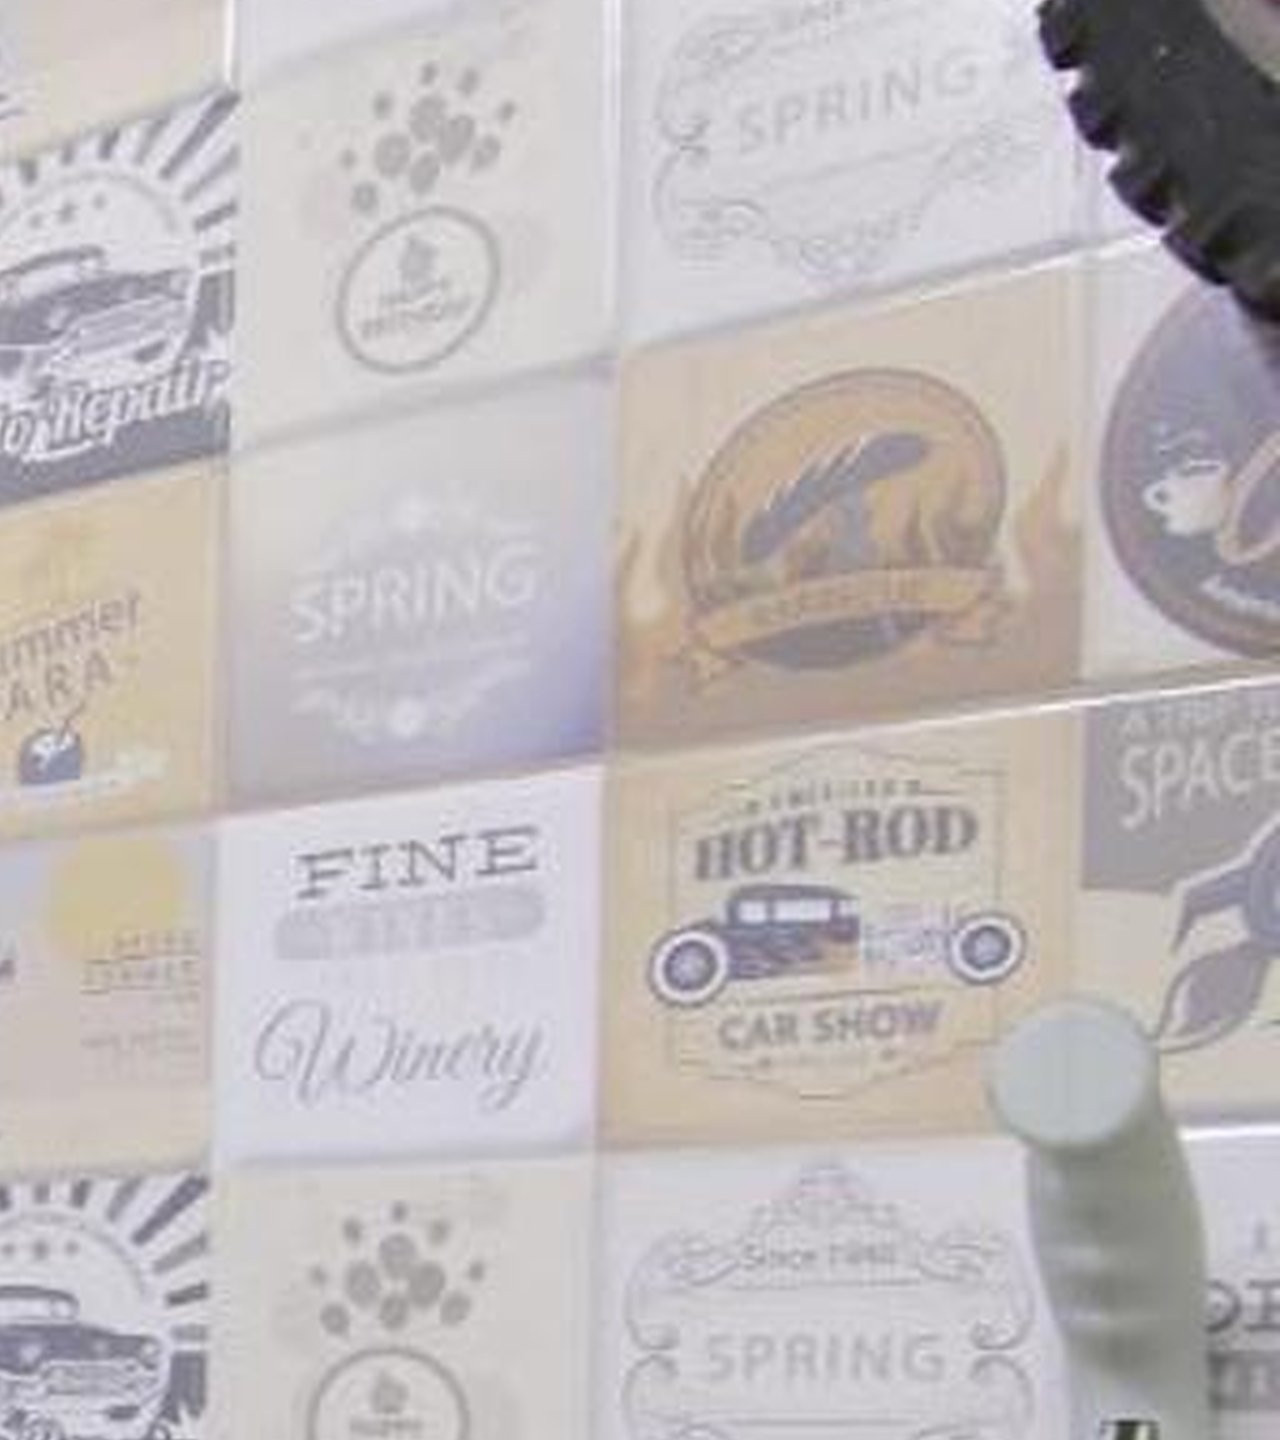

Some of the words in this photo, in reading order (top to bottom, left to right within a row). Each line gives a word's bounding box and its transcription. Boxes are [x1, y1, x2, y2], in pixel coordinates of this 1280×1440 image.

[737, 48, 981, 160] SPRING
[28, 358, 231, 462] Repair
[291, 546, 538, 645] SPRING
[296, 824, 540, 900] FINE
[252, 998, 548, 1113] Winery
[718, 1011, 799, 1054] CAR
[812, 998, 944, 1043] SHOW
[705, 1332, 946, 1383] SPRING
